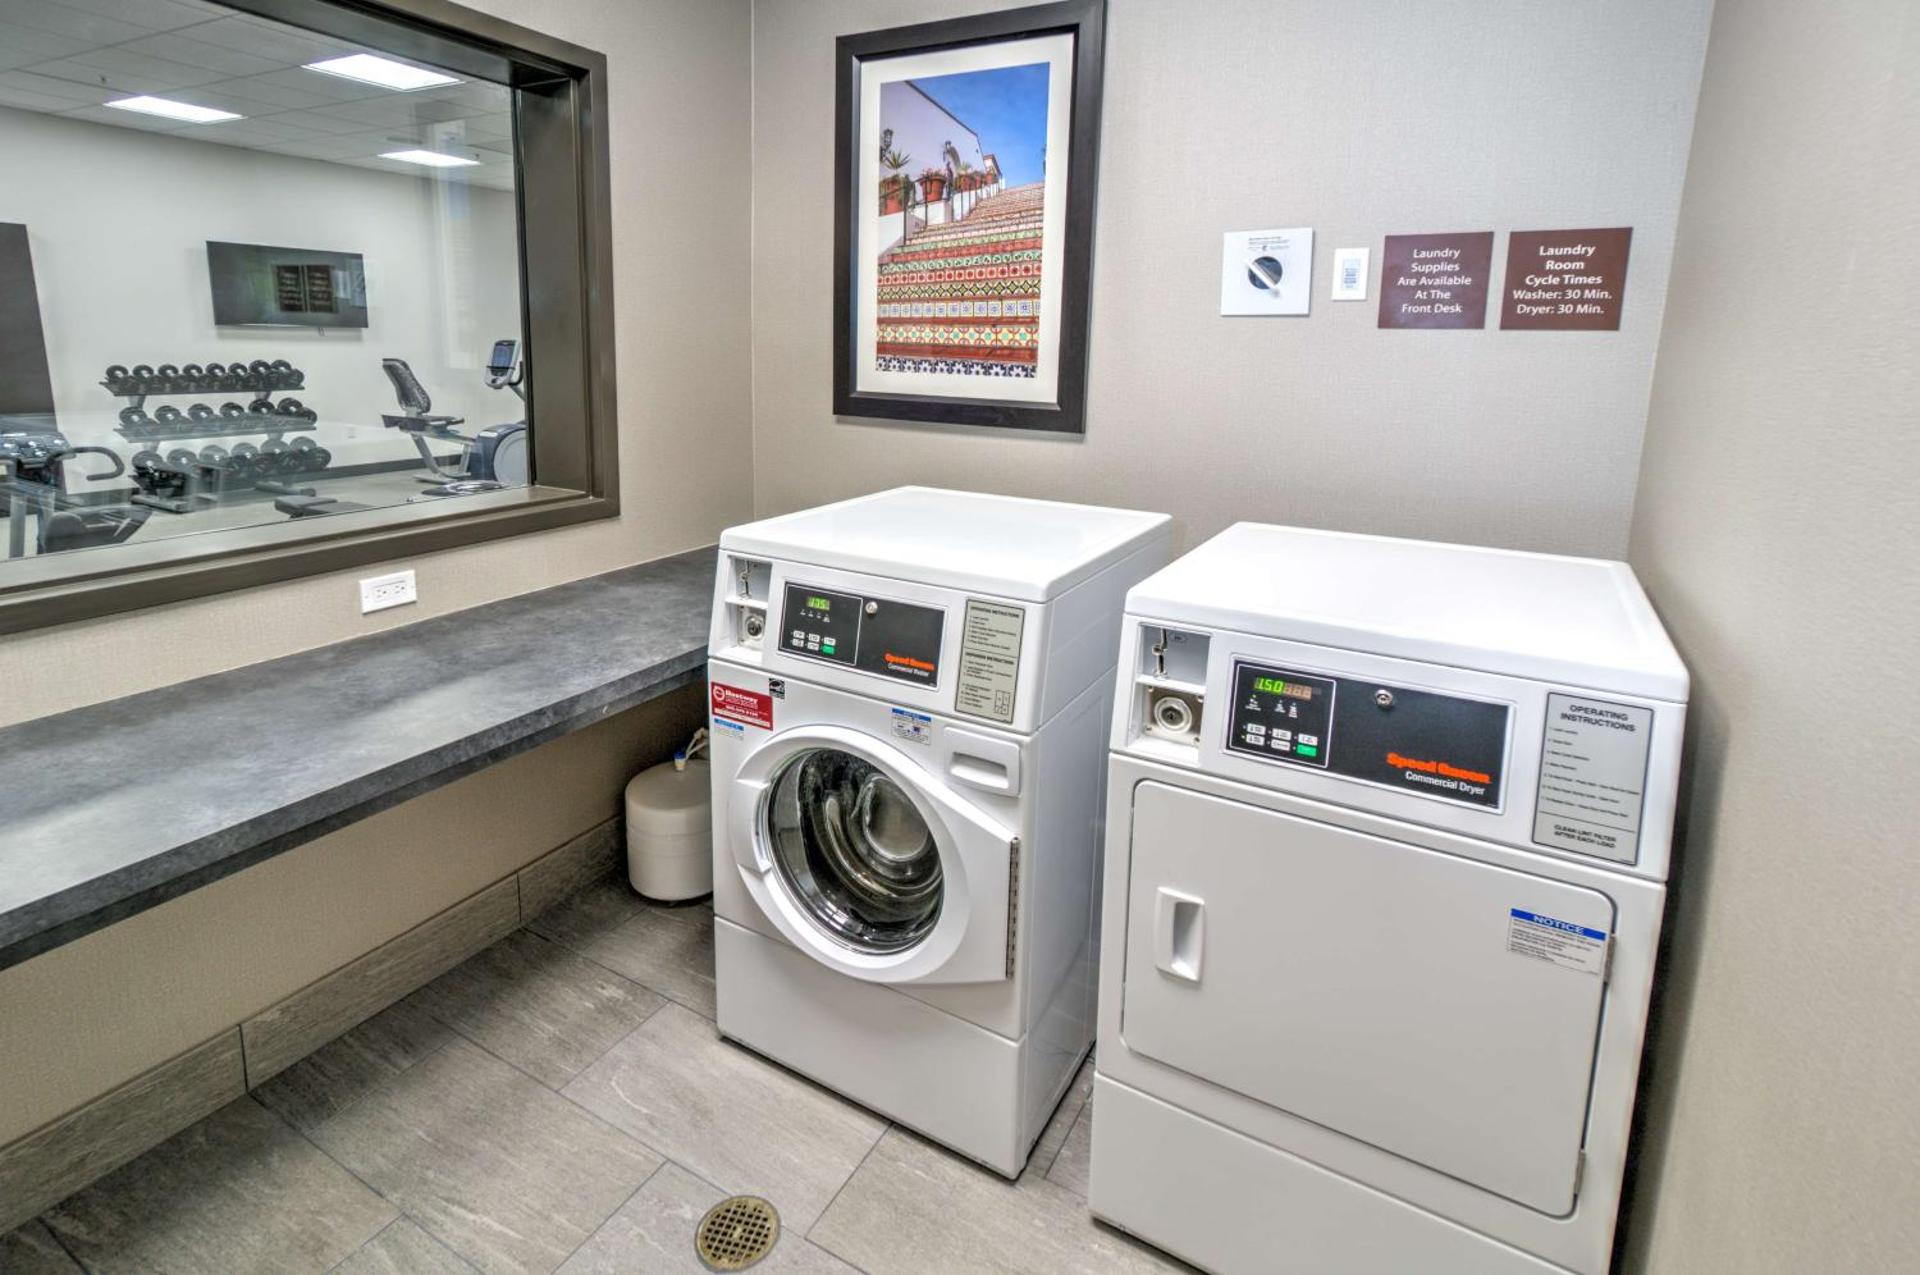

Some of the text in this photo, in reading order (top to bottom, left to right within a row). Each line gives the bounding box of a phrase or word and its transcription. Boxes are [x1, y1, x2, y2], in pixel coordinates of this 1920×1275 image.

[1413, 248, 1461, 259] Laundry
[1539, 244, 1596, 257] Laundry
[1411, 262, 1460, 274] Supplies
[1545, 260, 1585, 270] Room
[1397, 275, 1472, 286] Are Available
[1525, 274, 1603, 287] Cycle Times
[1415, 289, 1451, 299] At The
[1513, 289, 1612, 299] Washer: 30 Min.
[1401, 303, 1462, 313] Front Desk
[1517, 304, 1605, 316] Dryer: 30 Min.
[1569, 704, 1628, 721] OPERATING
[1561, 713, 1636, 732] INSTRUCTIONS
[1405, 771, 1485, 796] Commercial Dryer
[1533, 914, 1584, 936] NOTICE
